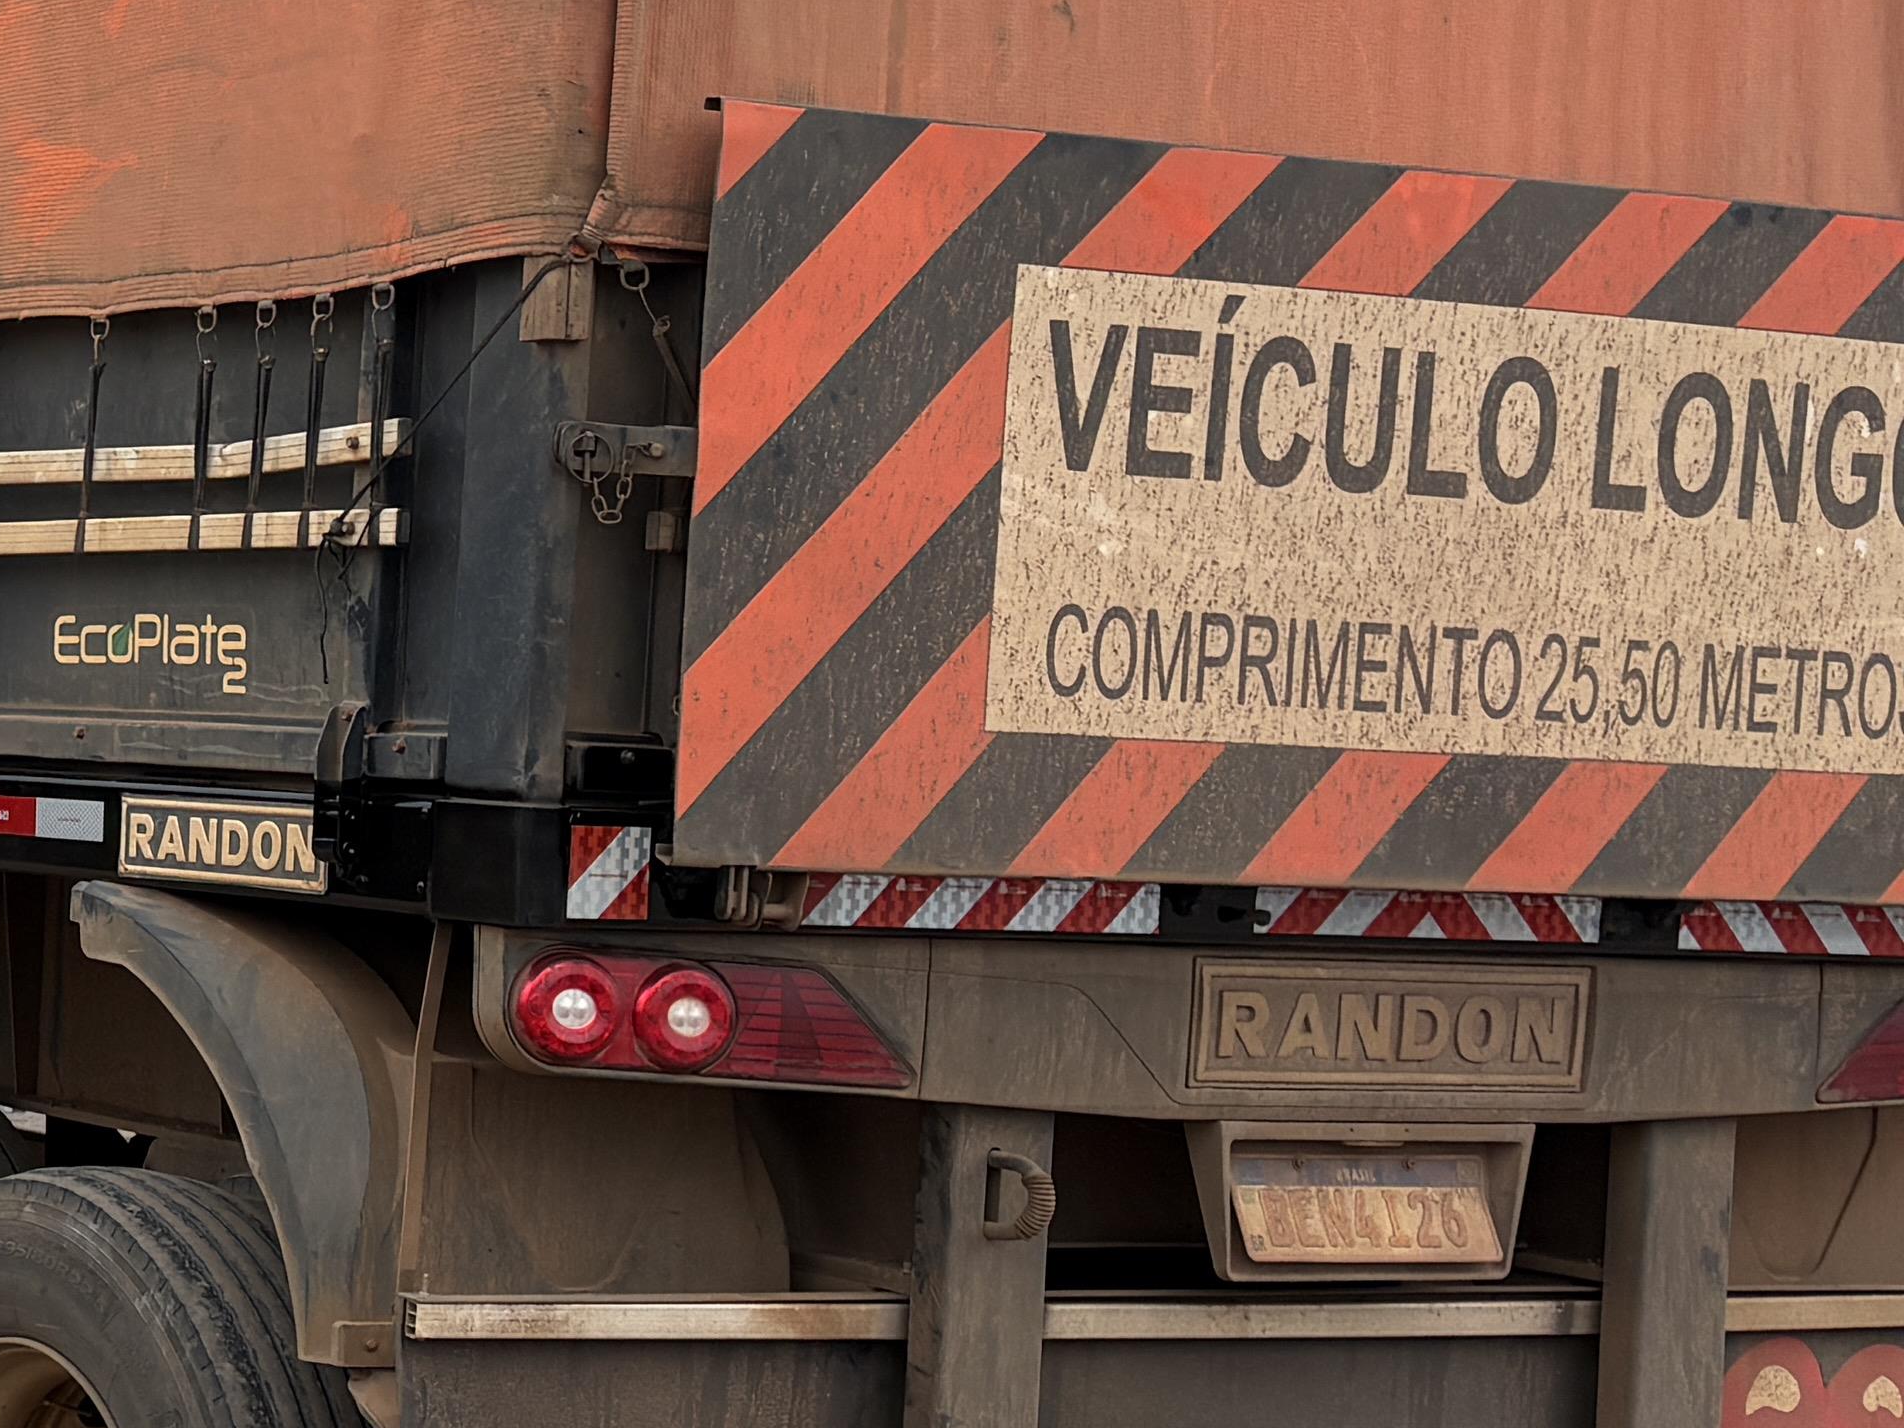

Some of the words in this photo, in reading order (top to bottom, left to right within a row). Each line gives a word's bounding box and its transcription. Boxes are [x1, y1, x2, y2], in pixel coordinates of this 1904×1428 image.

[1048, 294, 1558, 505] VEÍCULO
[1592, 365, 1904, 530] LONG
[1045, 603, 1522, 720] COMPRIMENTO
[1535, 633, 1680, 737] 25,50
[1697, 642, 1904, 740] METRO
[128, 812, 316, 873] RANDON
[1216, 989, 1567, 1065] RANDON
